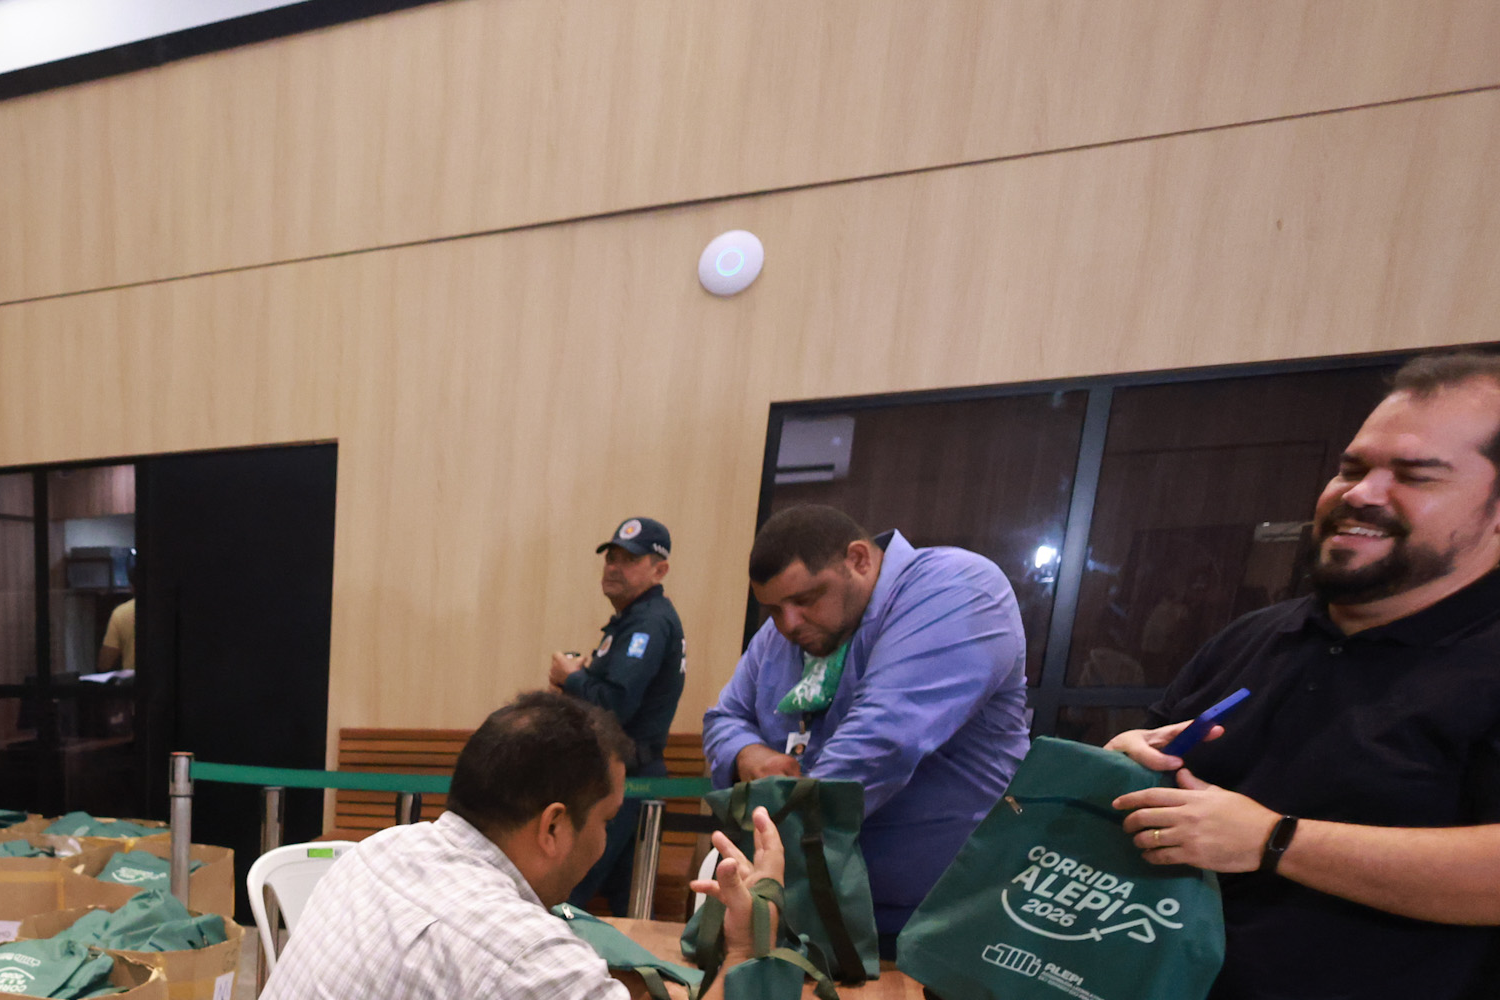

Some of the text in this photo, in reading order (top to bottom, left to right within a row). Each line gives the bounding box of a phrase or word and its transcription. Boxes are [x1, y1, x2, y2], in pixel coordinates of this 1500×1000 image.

[1011, 864, 1125, 921] ALEPI
[1028, 845, 1135, 899] CORRIDA
[1020, 899, 1077, 927] 2026
[1044, 963, 1084, 986] ALEPI
